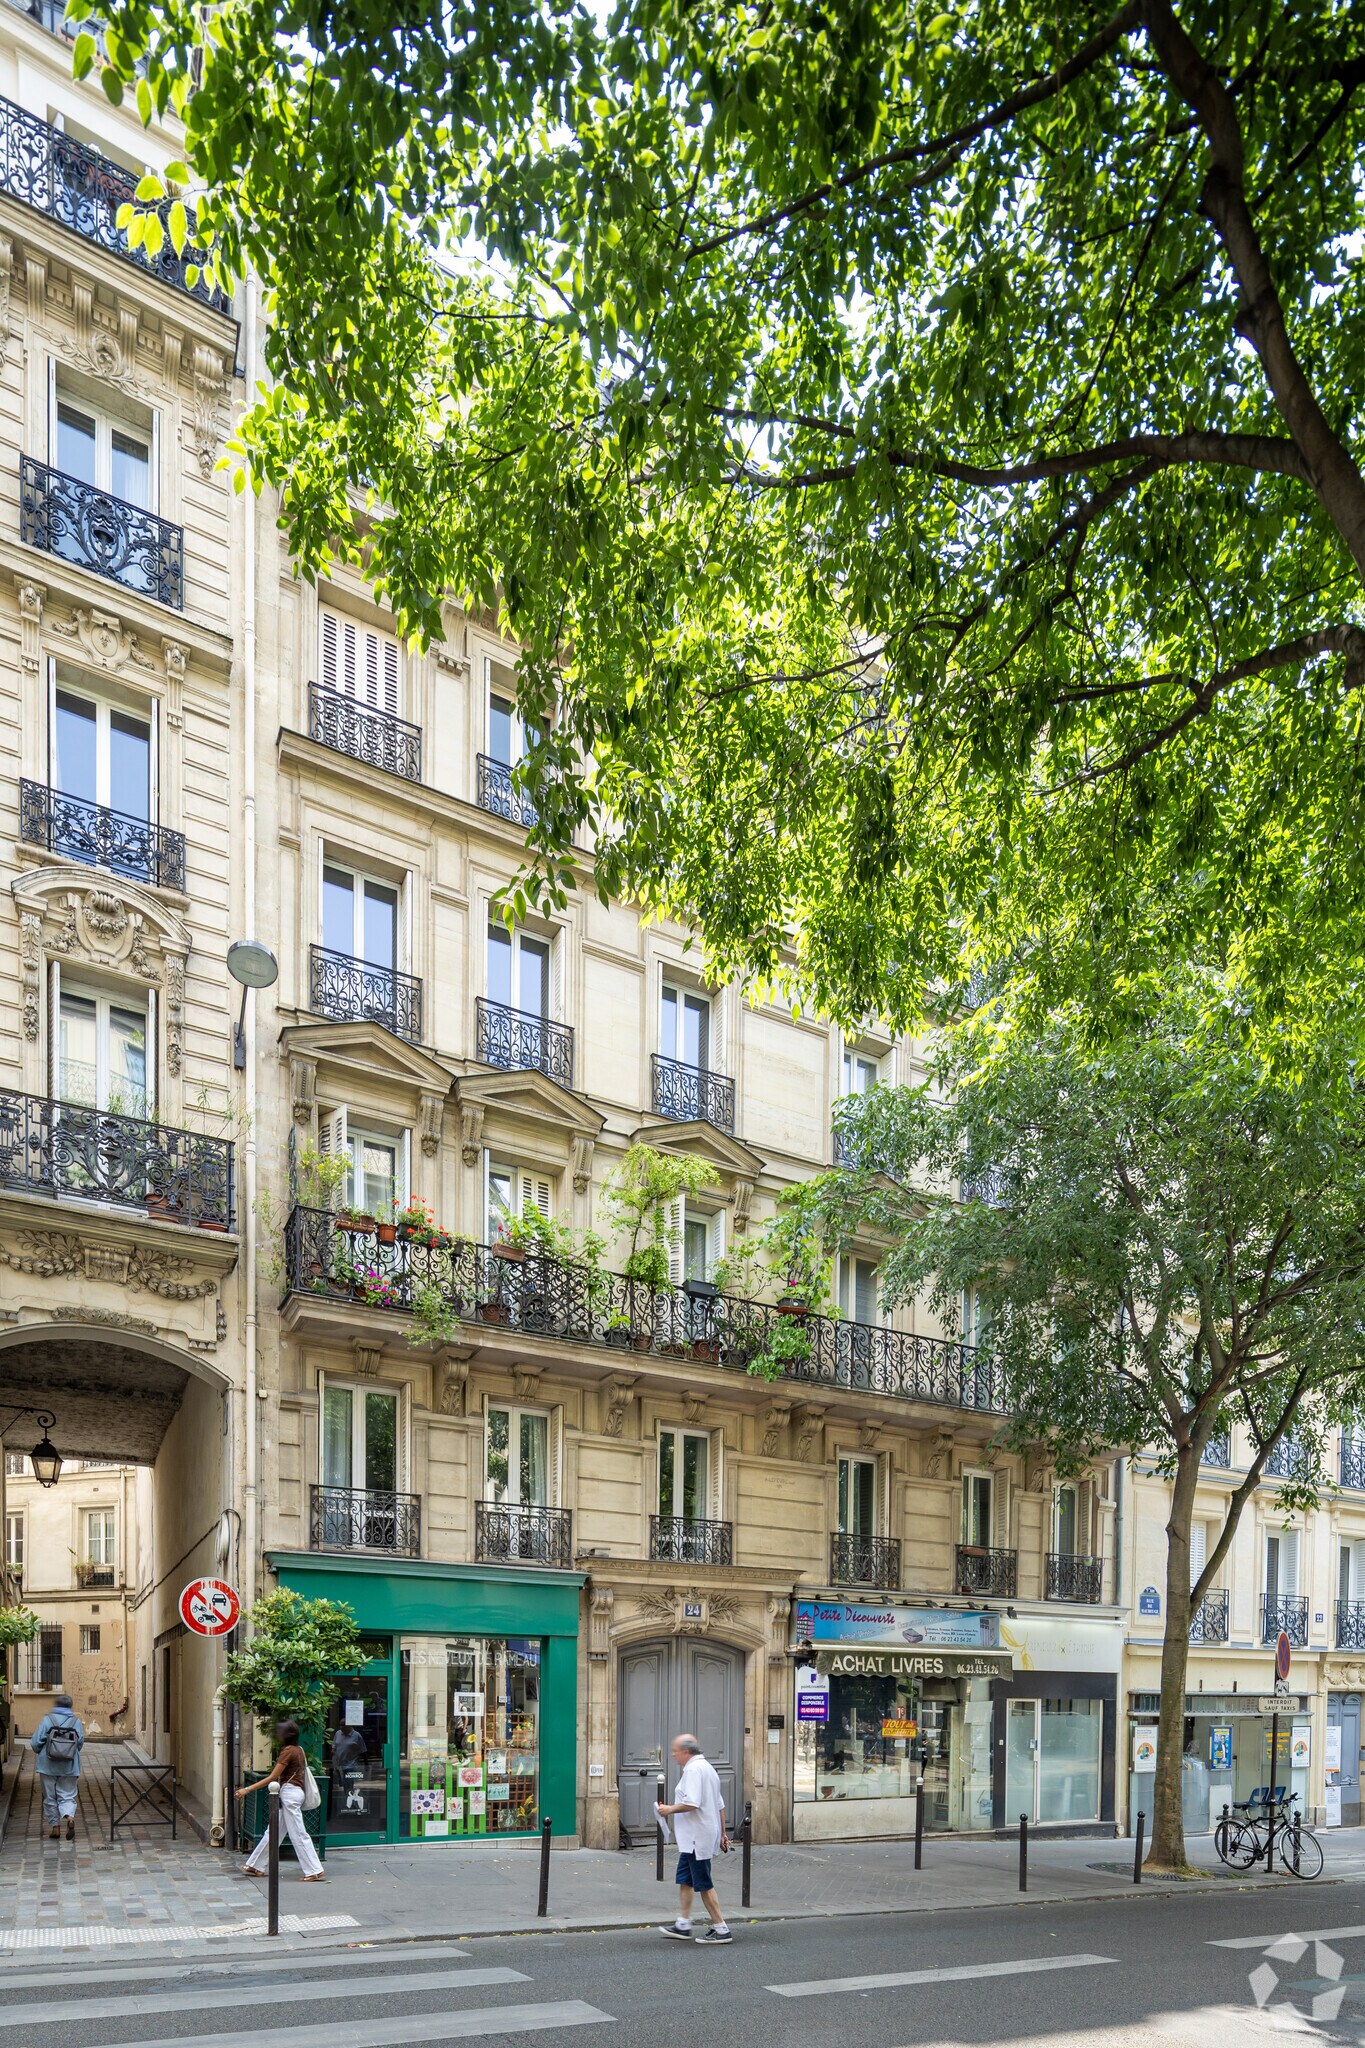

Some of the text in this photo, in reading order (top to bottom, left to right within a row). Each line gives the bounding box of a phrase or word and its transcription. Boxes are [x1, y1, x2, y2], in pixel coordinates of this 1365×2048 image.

[687, 1605, 700, 1616] 24
[797, 1604, 895, 1624] La Petite Découverte
[403, 1650, 537, 1667] LES NEVEUX DE RAMEAU
[831, 1655, 944, 1673] ACHAT LIVRES
[886, 1720, 906, 1728] TOUT
